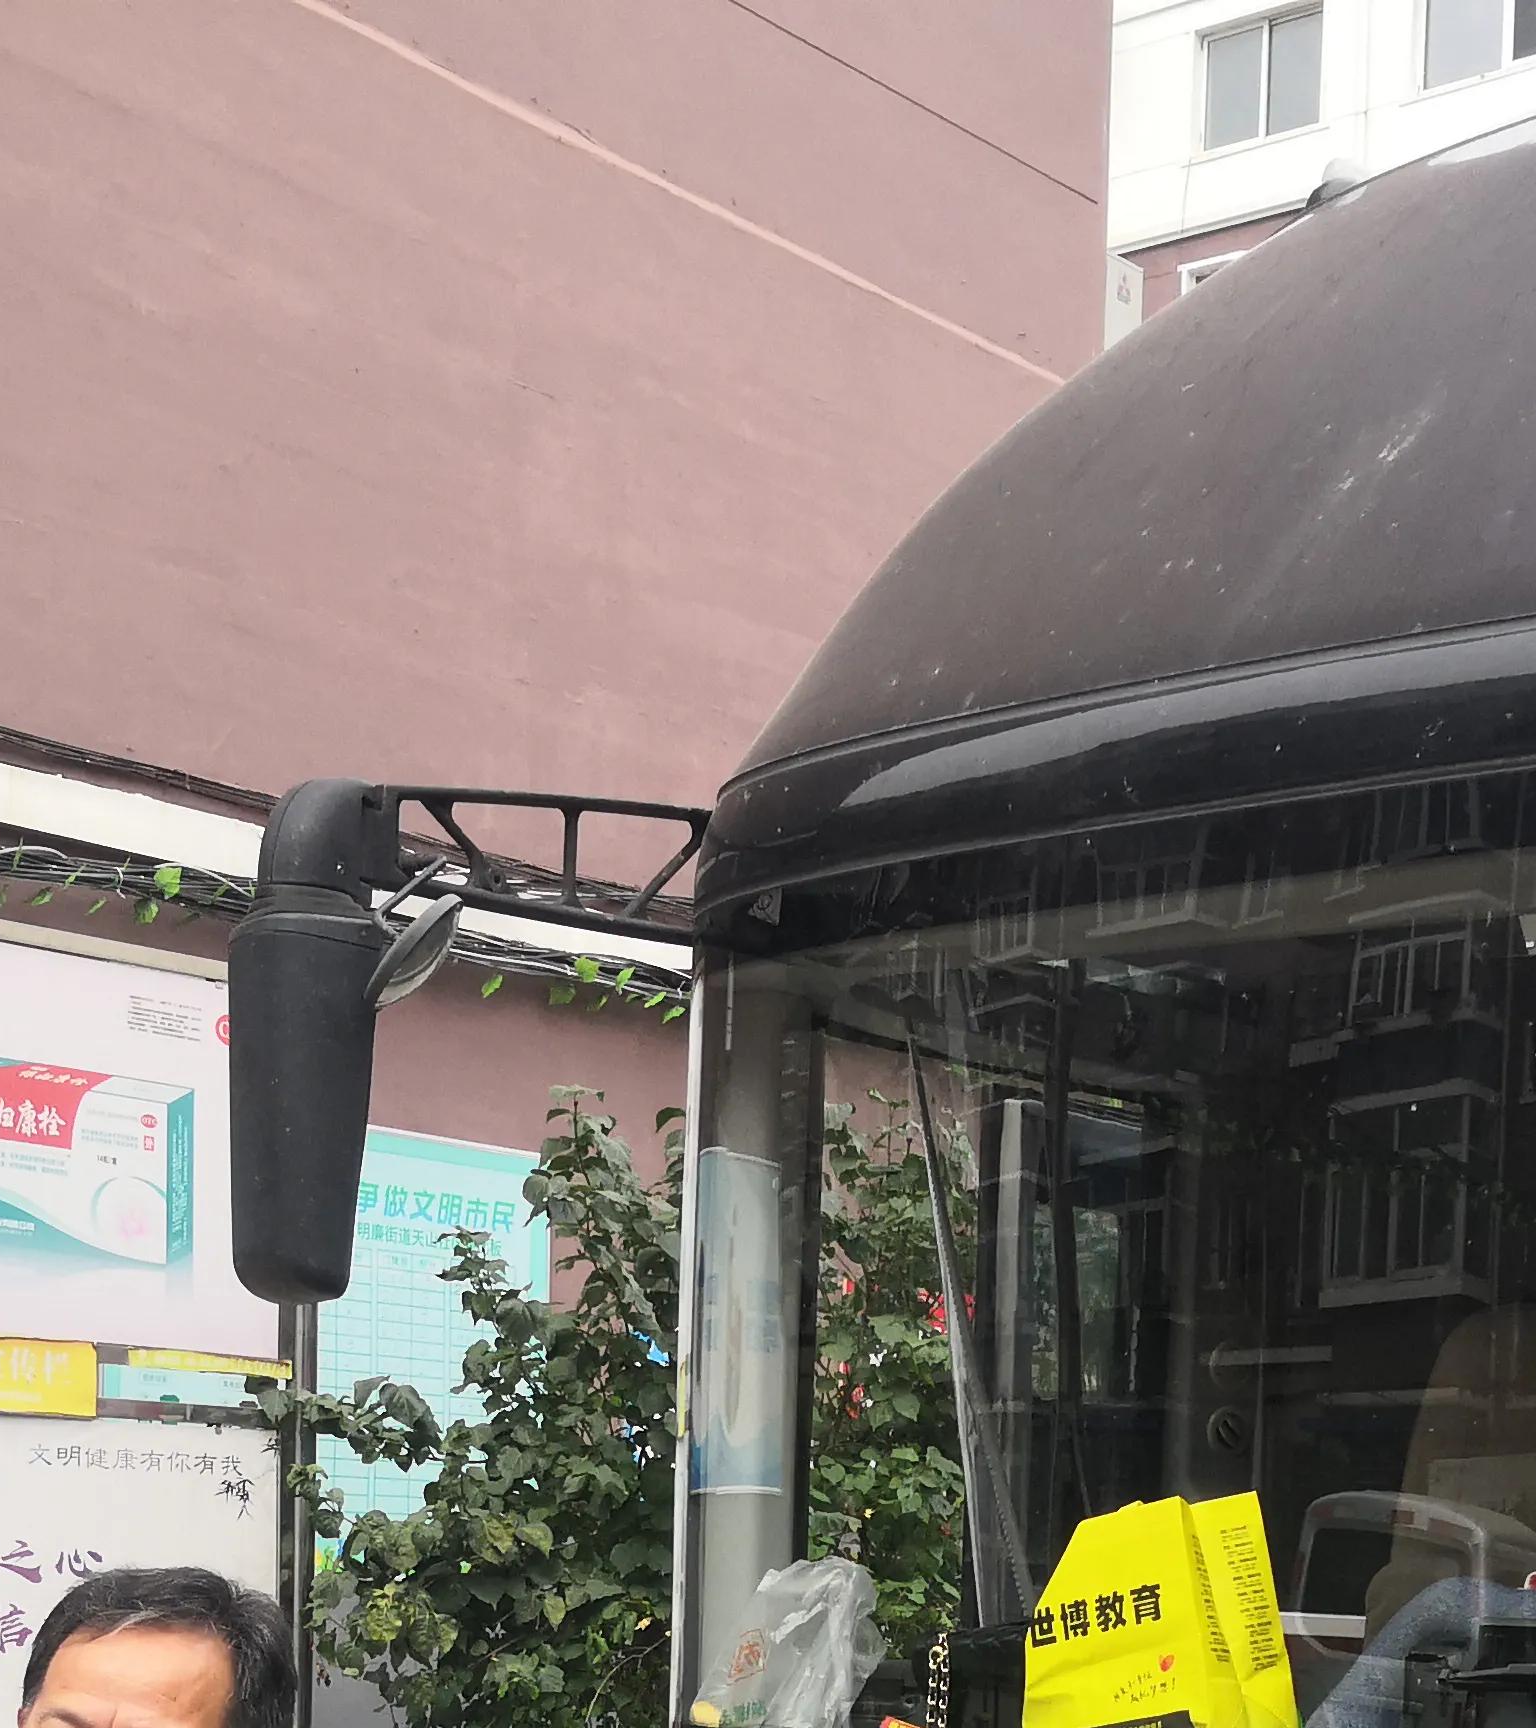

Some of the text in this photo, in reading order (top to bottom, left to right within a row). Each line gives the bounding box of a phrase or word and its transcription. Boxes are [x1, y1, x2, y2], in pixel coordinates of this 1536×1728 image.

[29, 1444, 244, 1478] 文明健康有你有我
[1030, 1584, 1161, 1648] 世博教育
